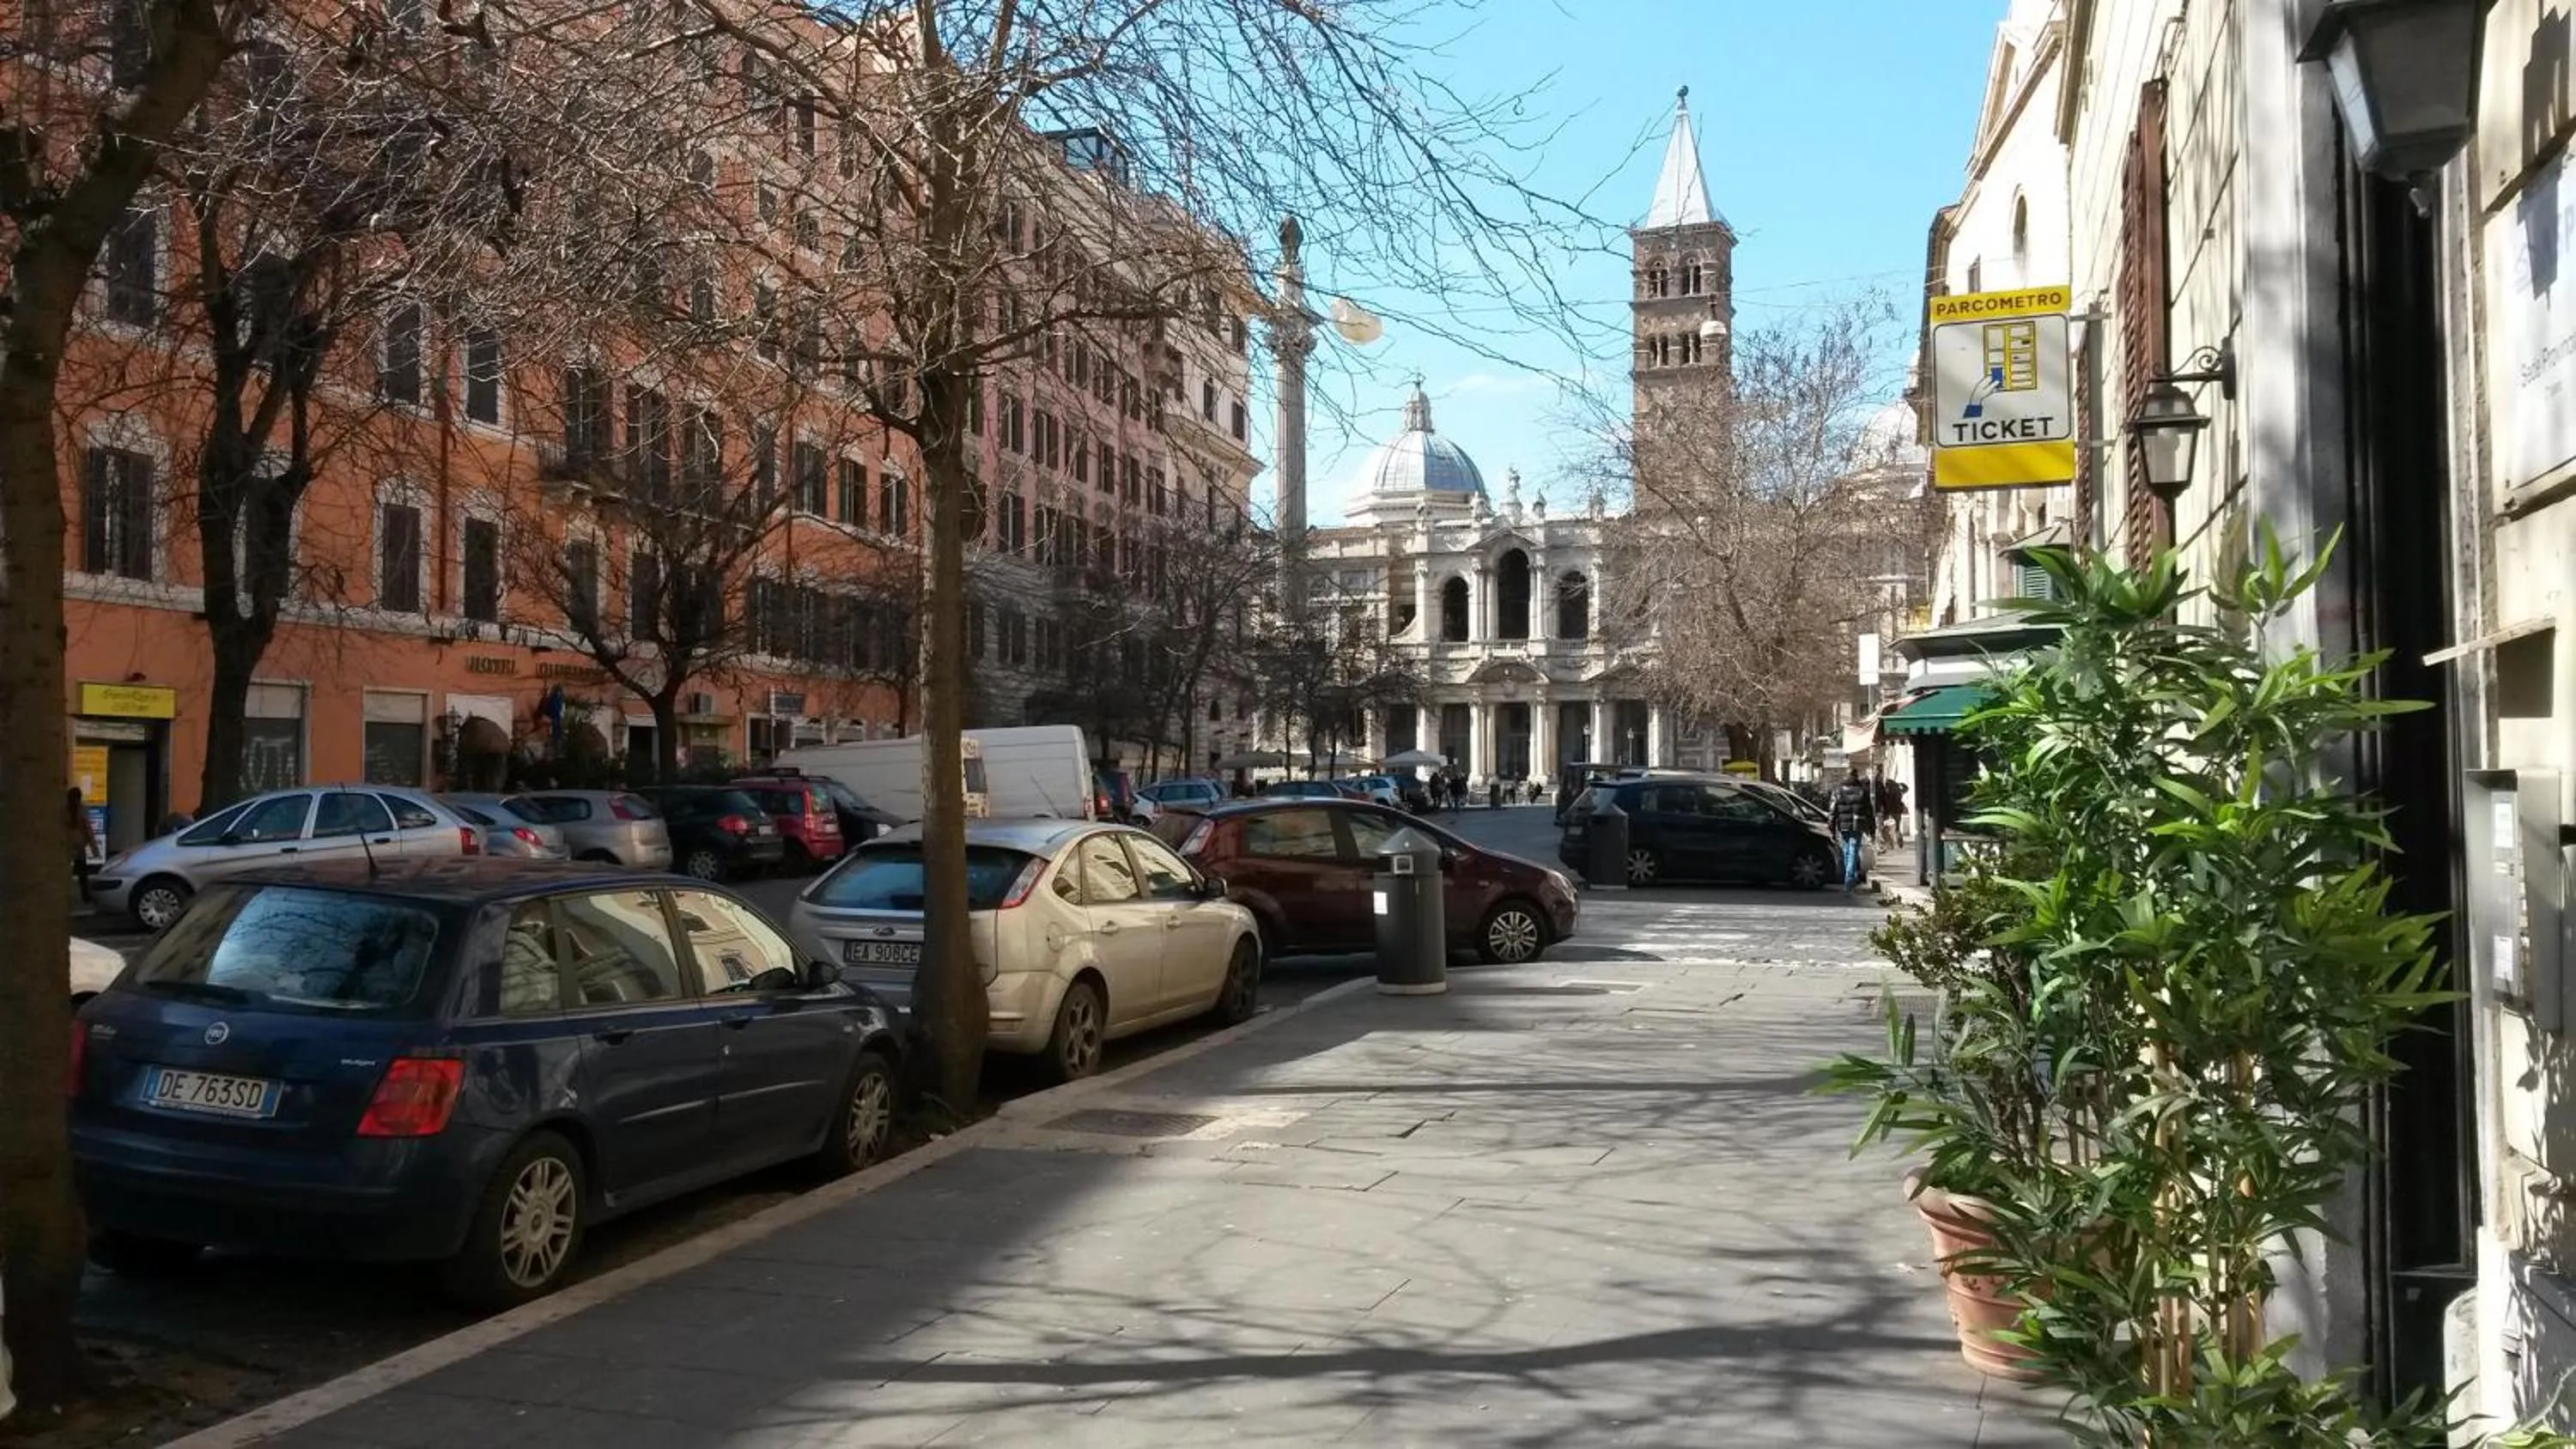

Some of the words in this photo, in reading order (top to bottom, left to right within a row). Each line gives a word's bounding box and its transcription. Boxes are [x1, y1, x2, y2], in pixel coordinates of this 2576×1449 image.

[1935, 292, 2063, 317] PARCOMETRO
[1952, 416, 2055, 442] TICKET
[853, 943, 870, 960] EA
[875, 945, 919, 962] 908CE
[158, 1071, 189, 1100] DE
[191, 1075, 264, 1109] 763SD
